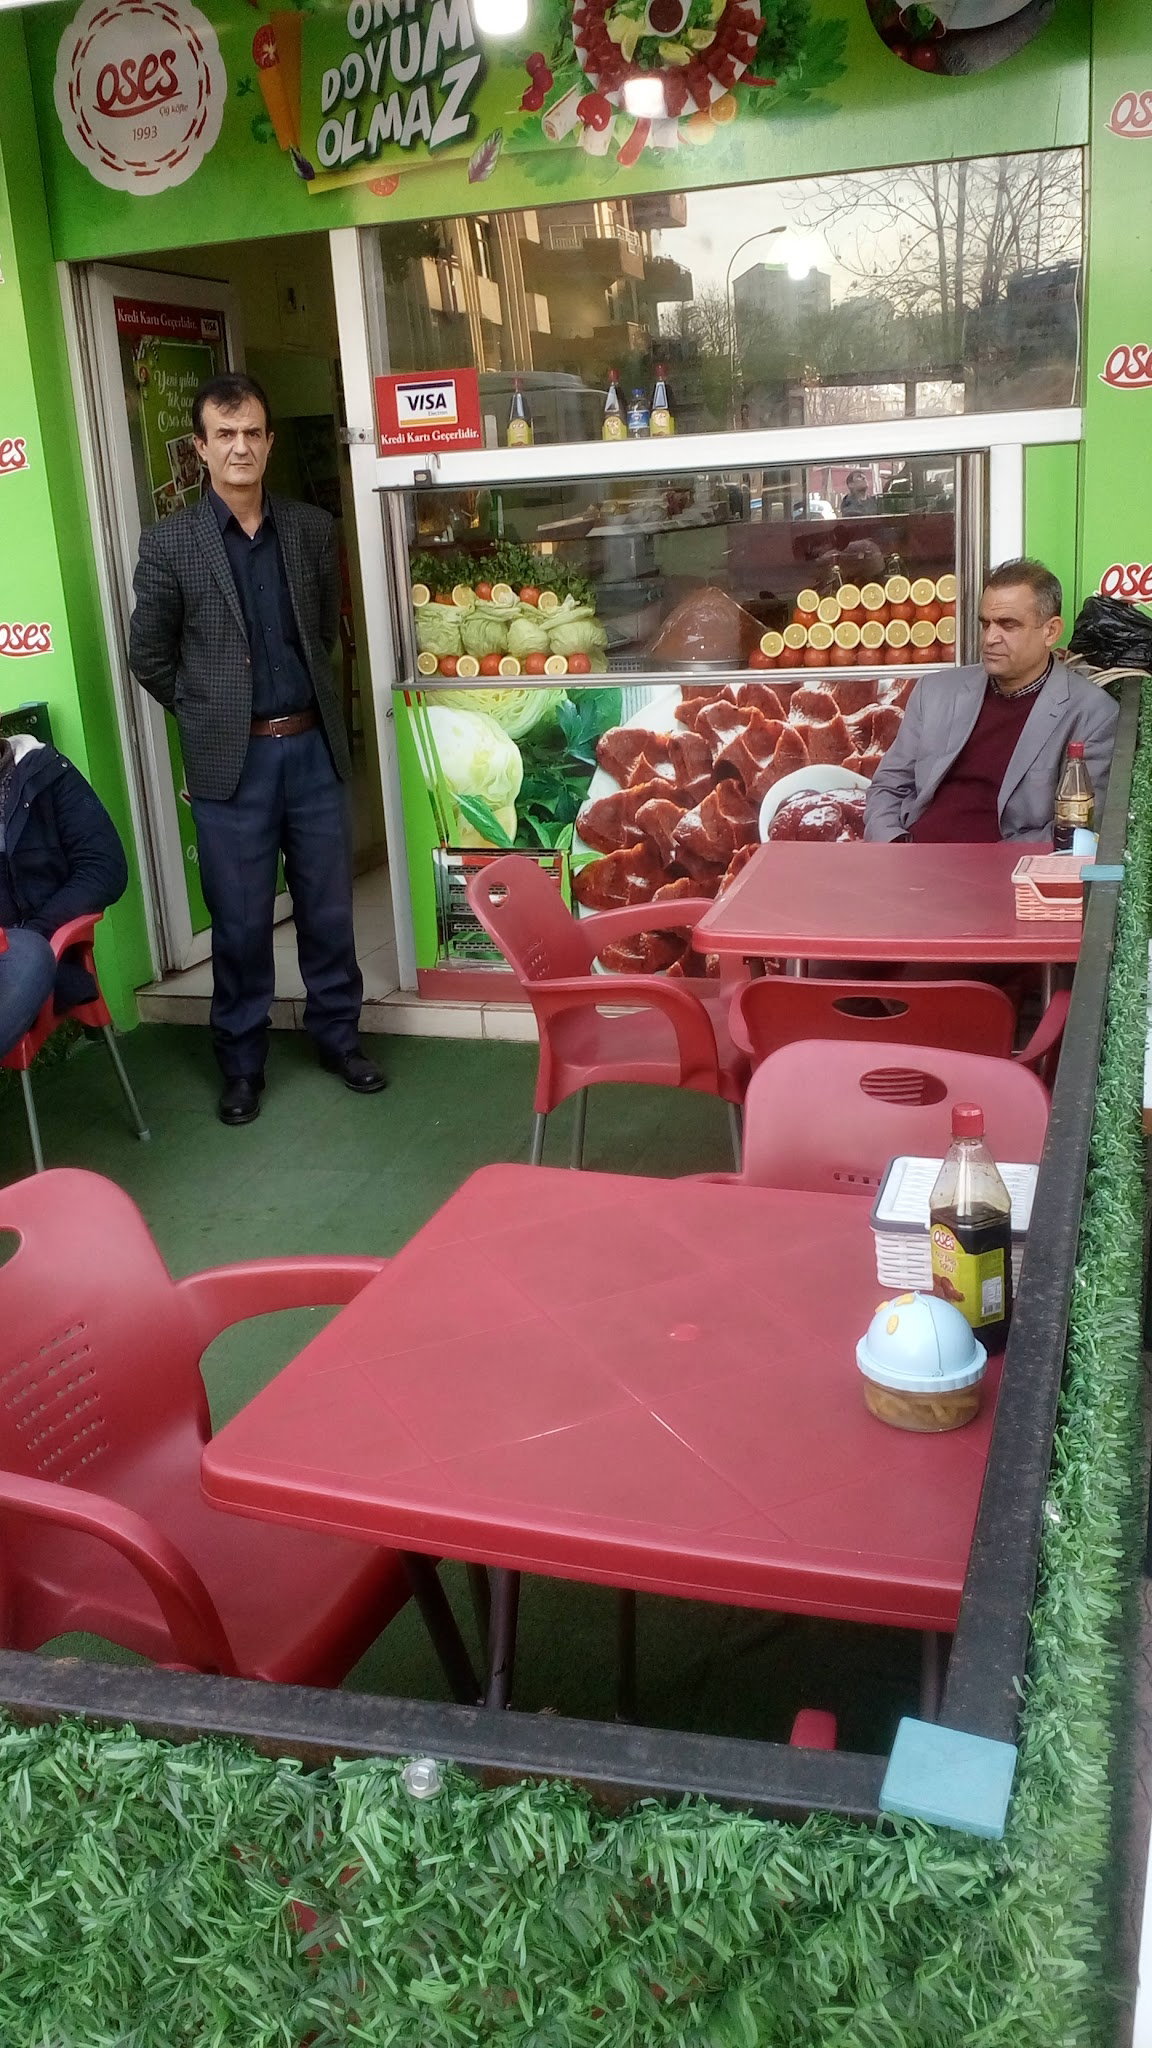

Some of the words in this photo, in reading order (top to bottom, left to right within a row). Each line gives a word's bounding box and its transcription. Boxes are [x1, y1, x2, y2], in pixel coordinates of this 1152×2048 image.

[322, 0, 475, 114] DOYUM
[94, 49, 181, 117] oses
[316, 54, 481, 167] OLMAZ
[133, 125, 157, 141] 1993
[117, 308, 139, 323] Kredi
[405, 393, 447, 411] VISA
[381, 433, 406, 445] Kredi
[407, 431, 431, 443] Kartı
[431, 427, 480, 442] Geçerlidir.
